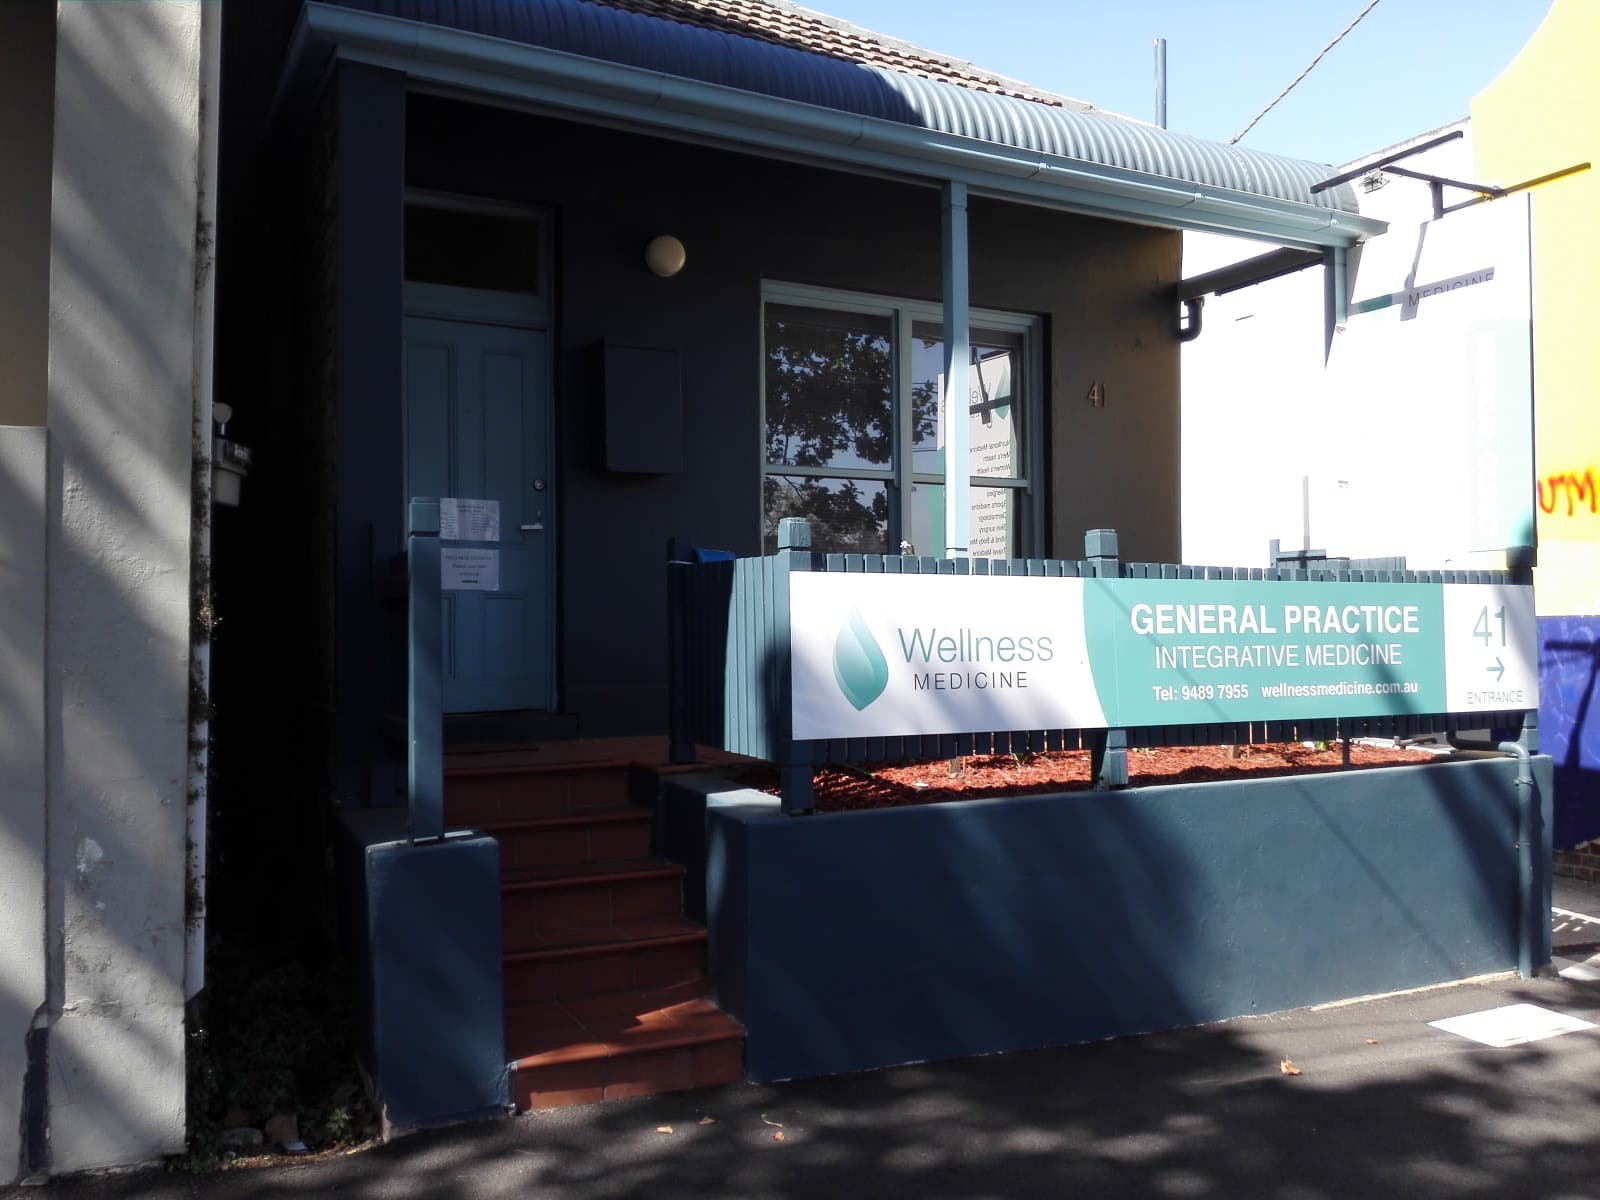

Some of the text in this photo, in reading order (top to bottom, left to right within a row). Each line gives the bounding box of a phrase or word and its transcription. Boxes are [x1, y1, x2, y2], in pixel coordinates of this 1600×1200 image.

[1085, 380, 1106, 408] 41
[1130, 603, 1420, 635] GENERAL PRACTICE
[1471, 605, 1507, 648] 41
[897, 627, 1054, 664] Wellness
[1155, 643, 1402, 670] INTEGRATIVE MEDICINE
[914, 671, 1028, 691] MEDICINE
[1152, 680, 1419, 702] Tel: 9489 7955 wellnessmedicine.com.au
[1467, 688, 1523, 706] ENTRANCE
